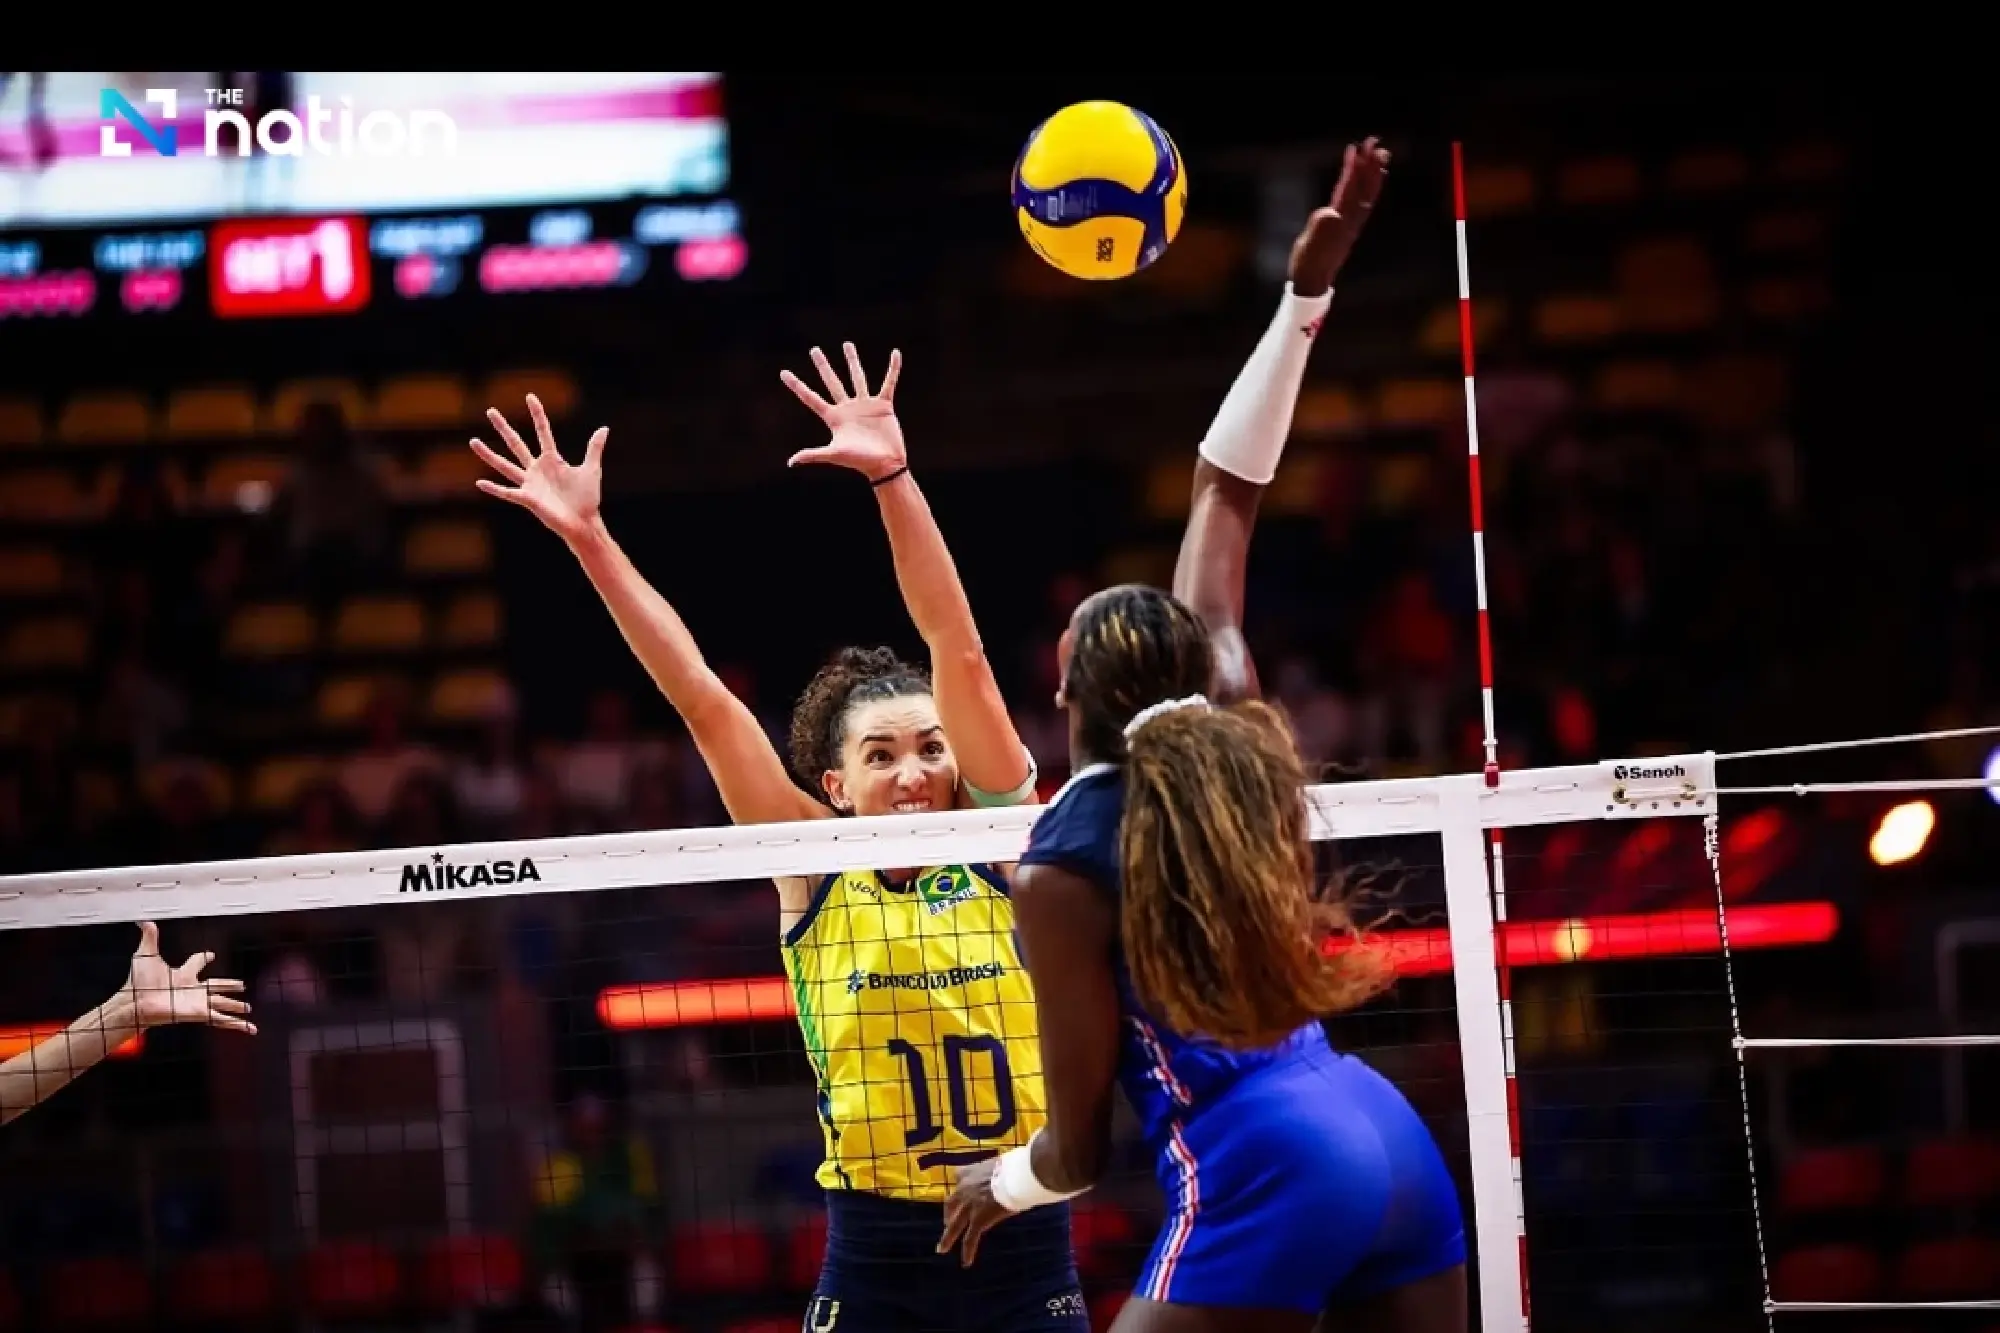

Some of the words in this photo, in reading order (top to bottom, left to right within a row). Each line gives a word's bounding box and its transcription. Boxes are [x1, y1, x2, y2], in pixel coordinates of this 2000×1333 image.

[1629, 764, 1686, 780] Senoh
[400, 853, 542, 893] MIKASA
[868, 972, 929, 990] BANCO
[887, 1034, 1017, 1148] 10
